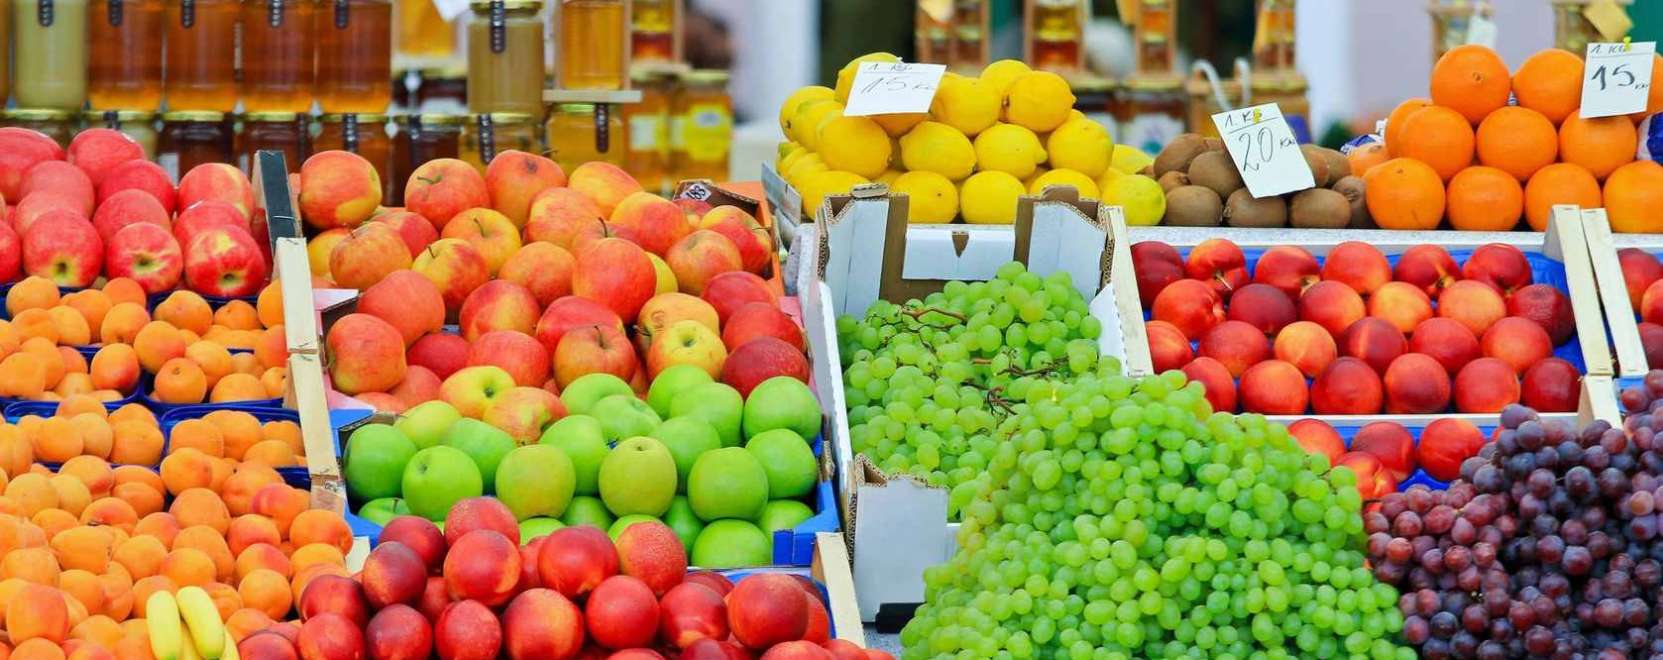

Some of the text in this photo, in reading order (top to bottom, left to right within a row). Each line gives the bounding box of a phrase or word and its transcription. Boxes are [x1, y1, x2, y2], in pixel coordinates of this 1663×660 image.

[861, 76, 910, 94] 15
[1591, 63, 1636, 91] 15
[1239, 127, 1273, 172] 20
